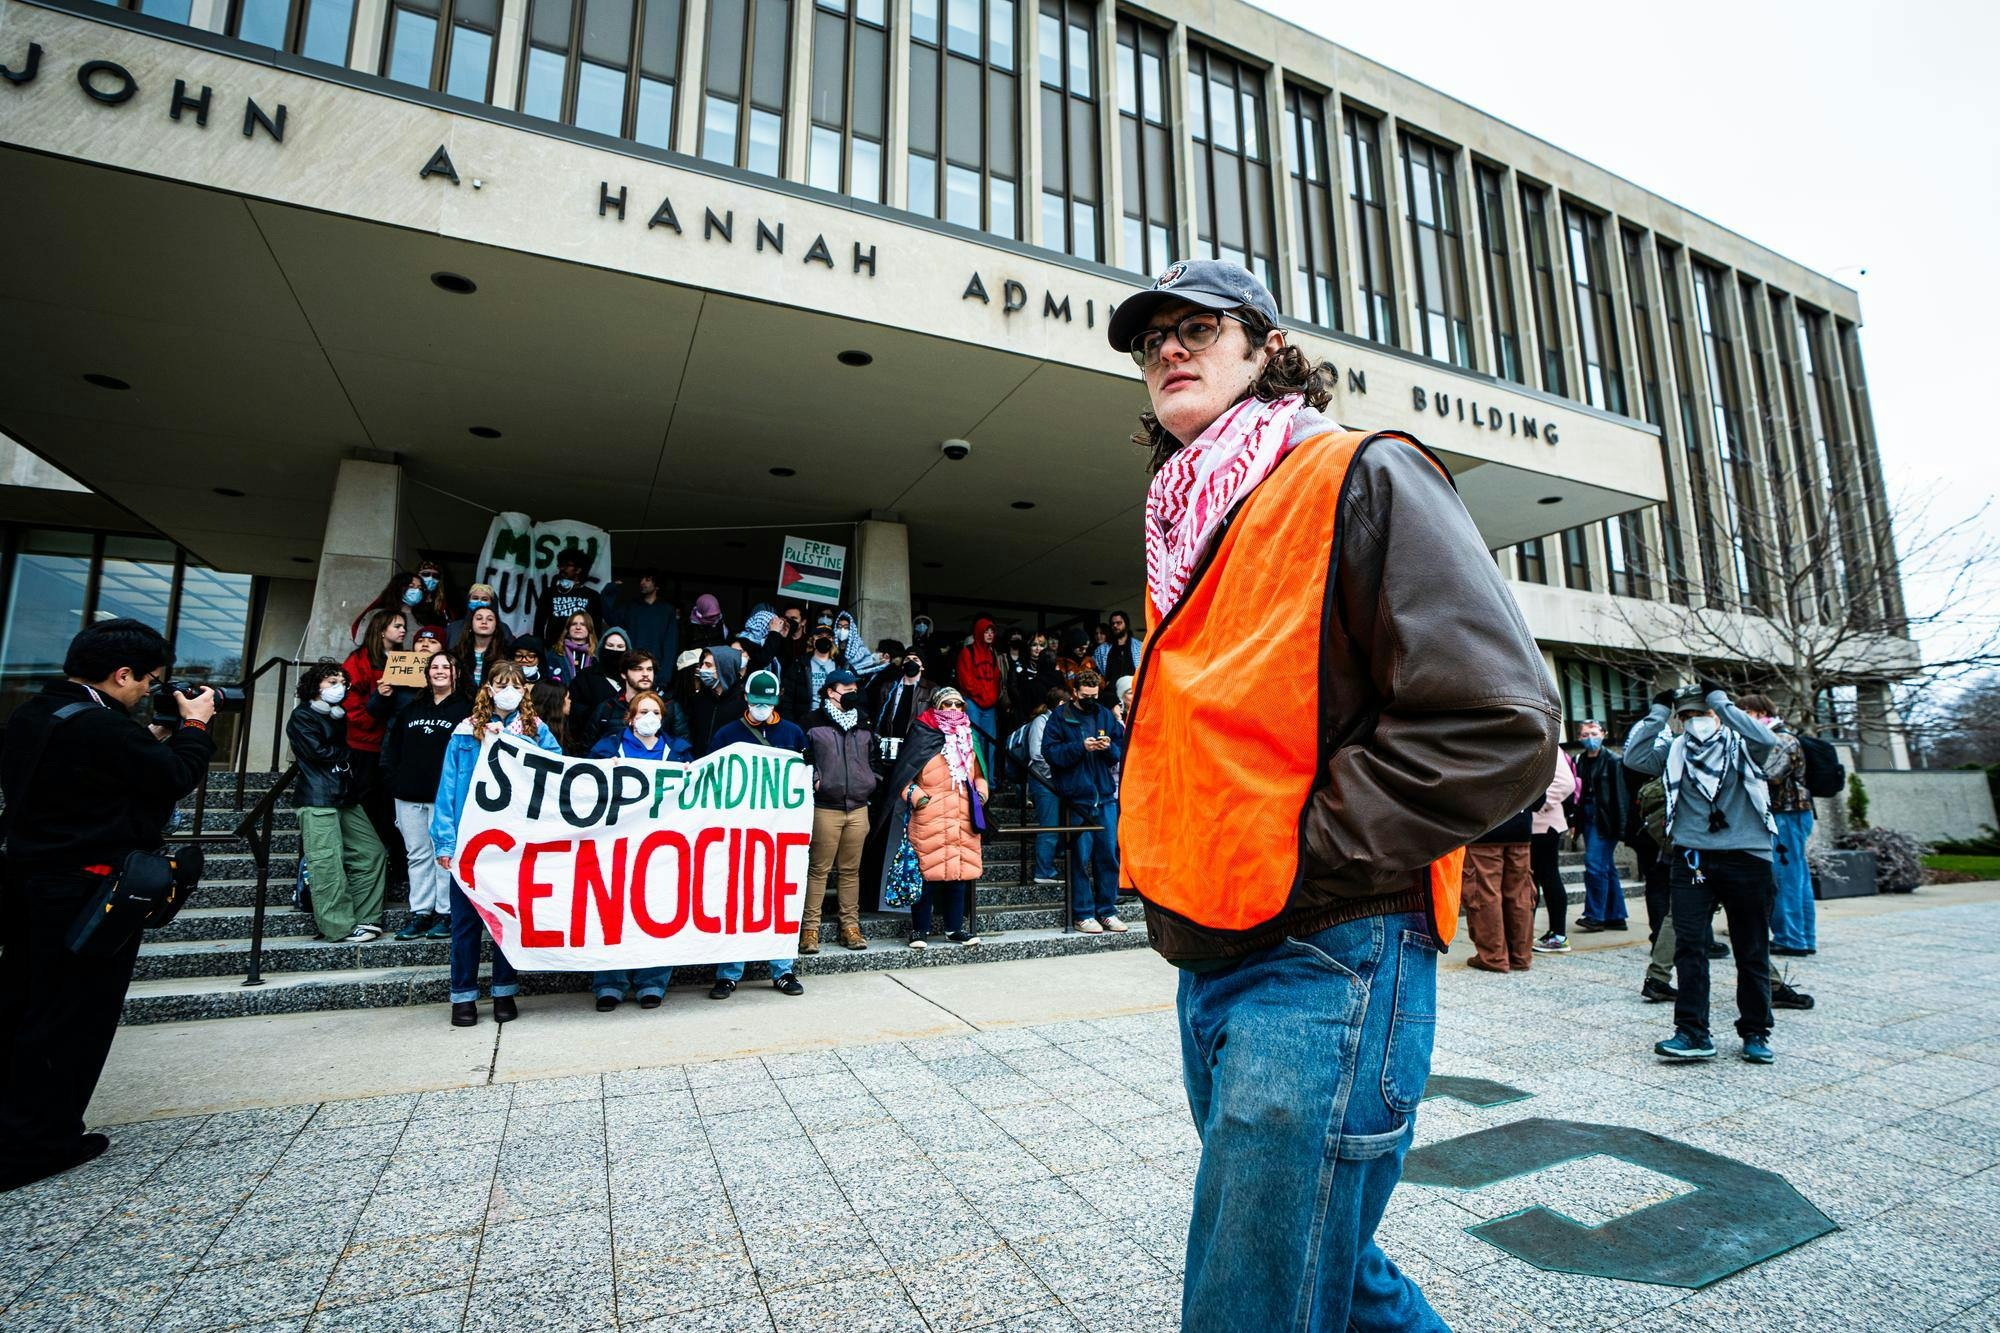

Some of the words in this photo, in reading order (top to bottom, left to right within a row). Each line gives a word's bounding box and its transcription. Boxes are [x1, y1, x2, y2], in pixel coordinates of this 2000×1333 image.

[0, 42, 287, 143] JOHN
[599, 181, 877, 277] HANNAH
[962, 271, 1115, 329] ADMI
[1412, 385, 1559, 446] BUILDING
[784, 546, 842, 570] PALESTINE
[804, 541, 832, 556] FREE
[391, 655, 406, 663] WE
[389, 665, 413, 675] THE
[408, 718, 453, 729] UNSALTED
[475, 738, 650, 828] STOP
[649, 754, 805, 818] FUNDING
[459, 826, 811, 948] GENOCIDE
